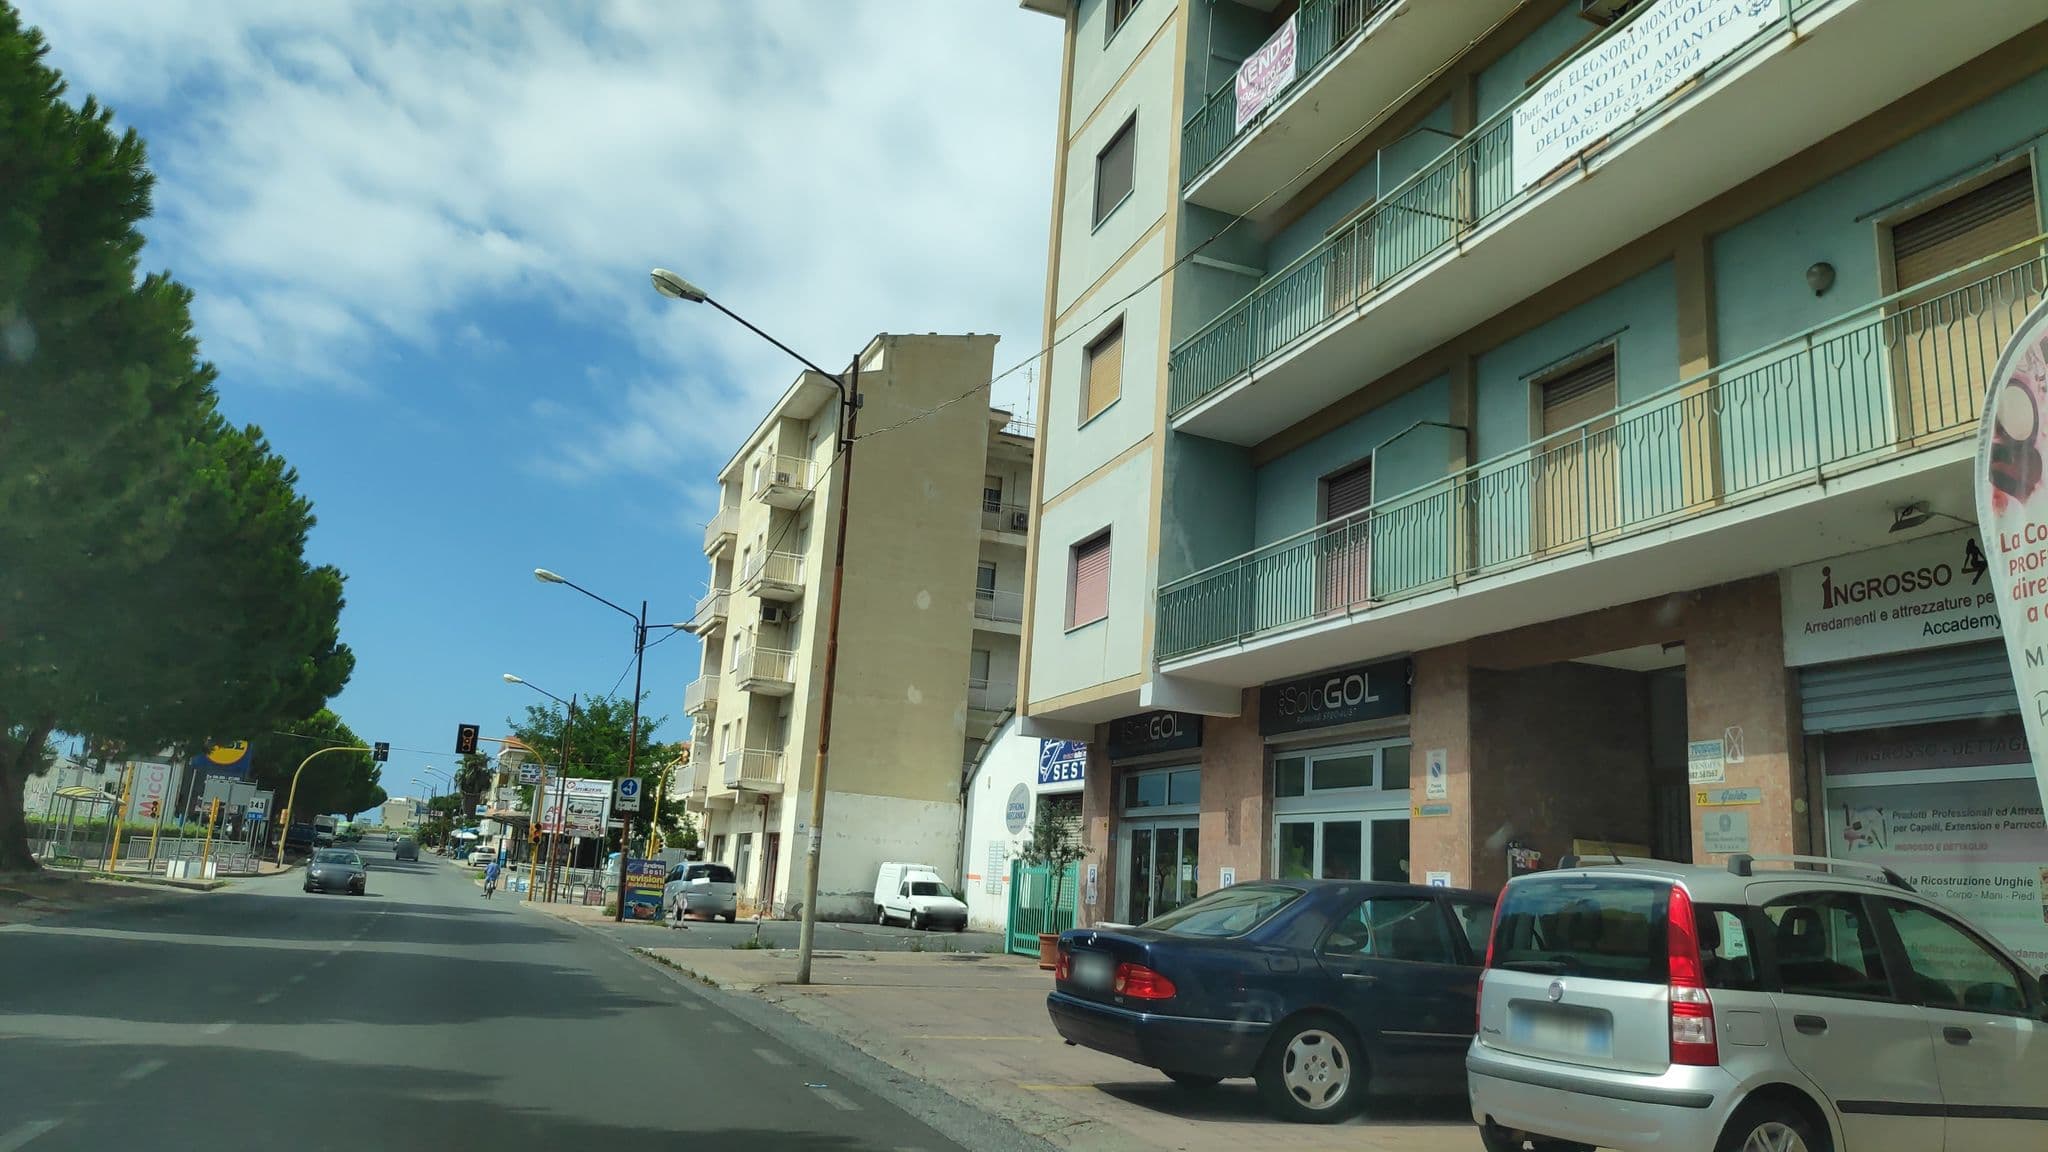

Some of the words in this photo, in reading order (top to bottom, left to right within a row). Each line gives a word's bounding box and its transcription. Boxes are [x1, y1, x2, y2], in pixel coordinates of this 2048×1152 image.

[1536, 115, 1579, 152] DELLA
[1584, 84, 1625, 120] SEDE
[1631, 69, 1648, 89] DI
[1653, 4, 1741, 75] AMANTEA
[1543, 80, 1566, 106] Prof.
[1568, 32, 1637, 87] ELEONORA
[1531, 93, 1577, 135] UNICO
[1583, 44, 1648, 97] NOTAIO
[1565, 121, 1599, 149] Info:
[2000, 532, 2020, 553] La
[2013, 576, 2048, 601] dire
[1804, 612, 1876, 635] Arredamenti
[1880, 611, 1888, 621] e
[1892, 596, 1972, 619] attrezzature
[1923, 614, 2001, 636] Accademy
[1697, 792, 1708, 804] 73
[1932, 807, 1993, 818] Professionali
[1995, 806, 2008, 817] ed
[1893, 824, 1907, 835] per
[1945, 820, 1992, 831] Extension
[1921, 876, 1991, 886] Ricostruzione
[1994, 877, 2034, 888] Unghie
[1946, 890, 1973, 900] Corpo
[1981, 890, 2003, 899] Mani
[2011, 890, 2035, 900] Piedi
